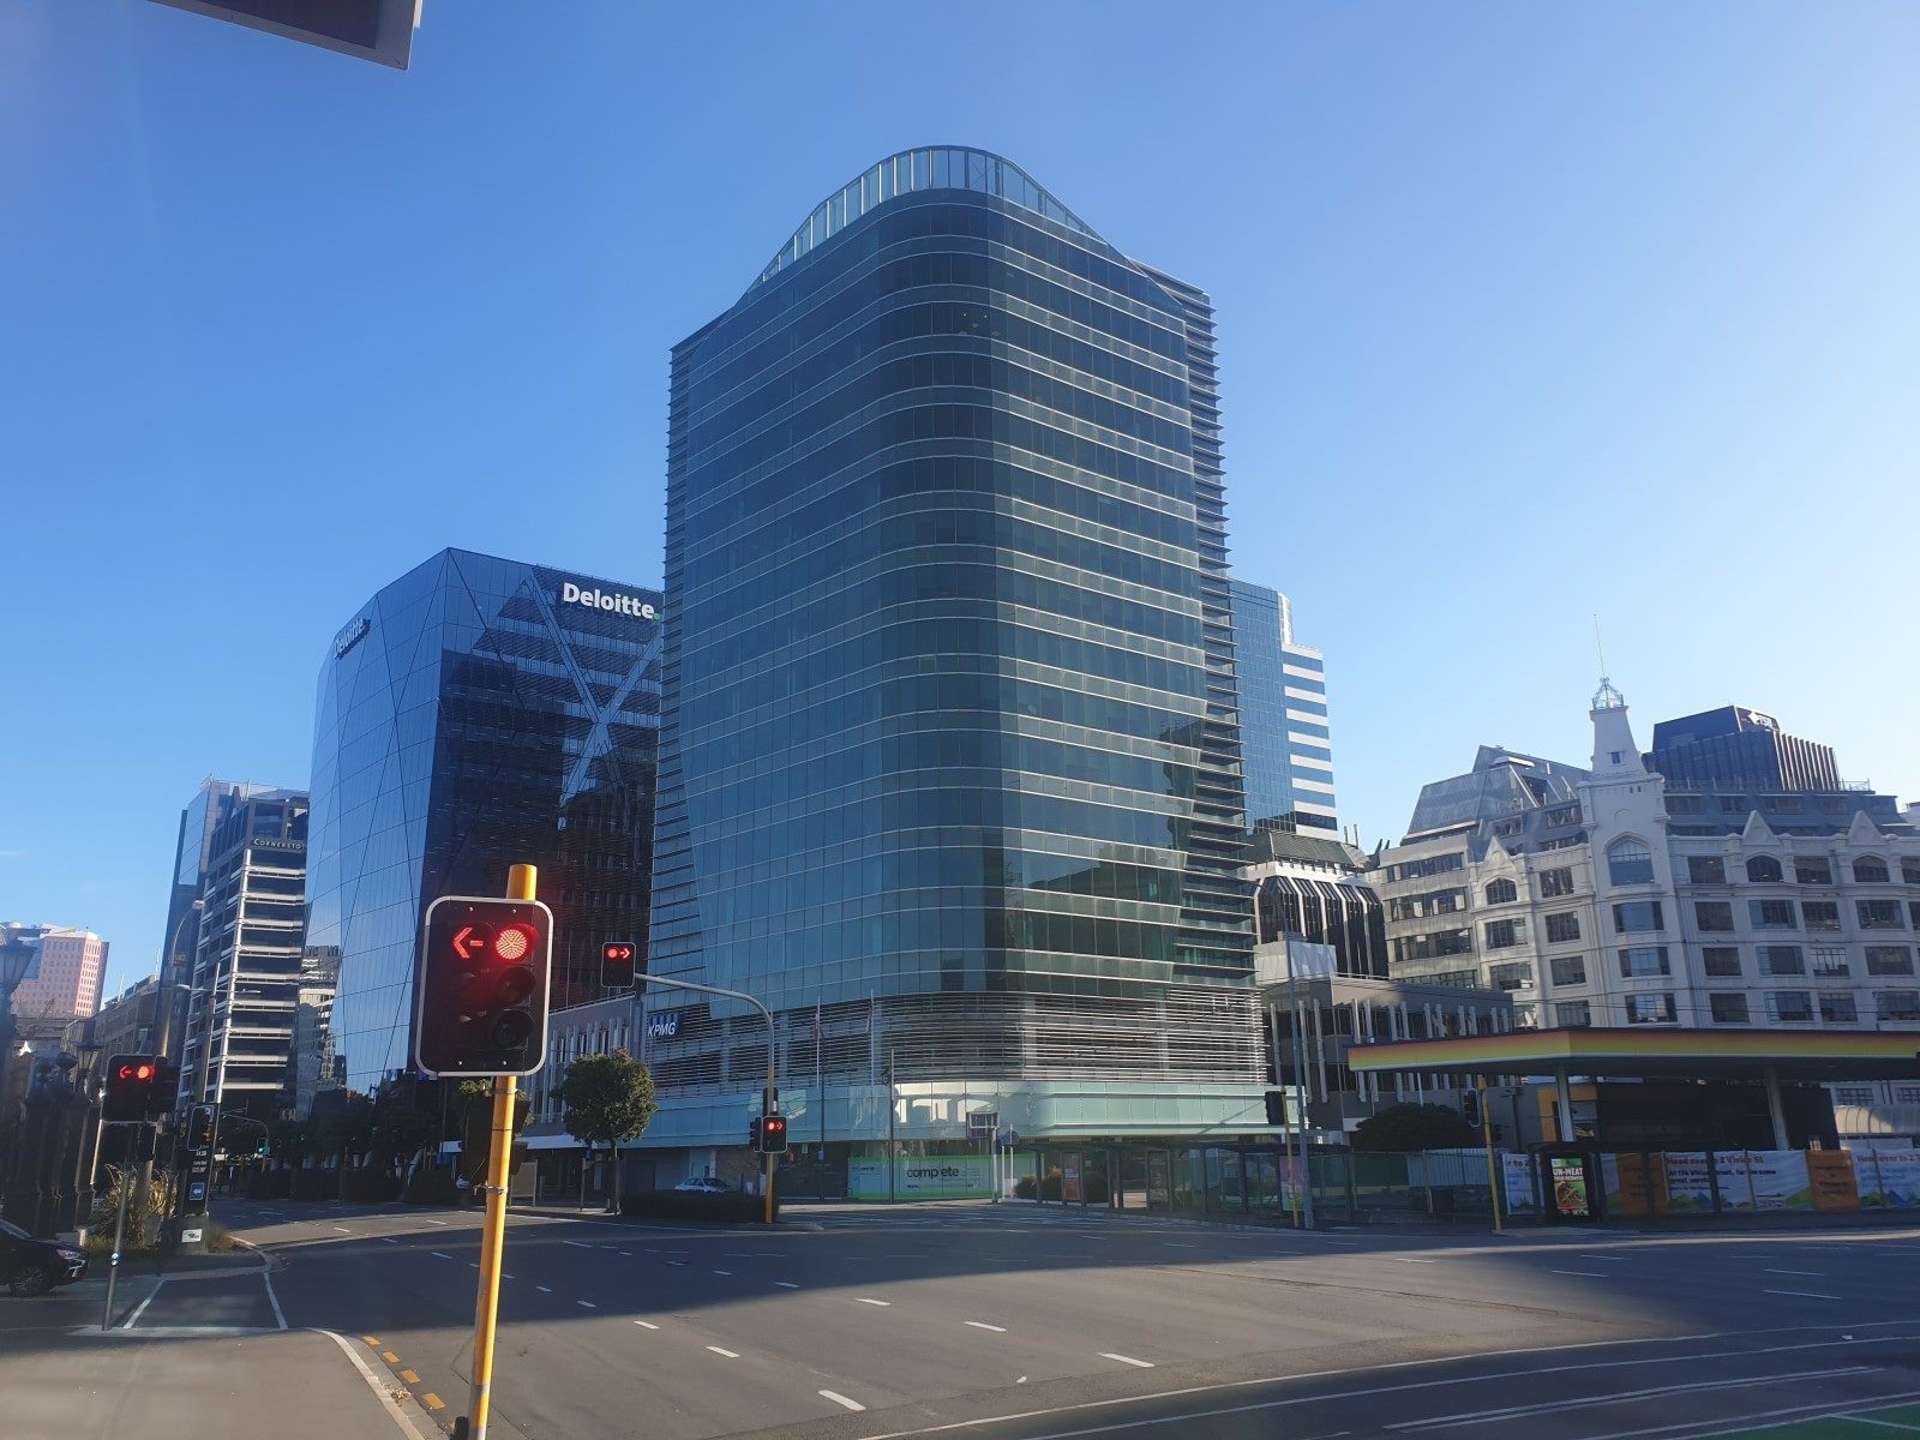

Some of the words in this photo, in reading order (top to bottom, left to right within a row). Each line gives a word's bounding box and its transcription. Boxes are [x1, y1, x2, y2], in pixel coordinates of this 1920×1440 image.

[253, 838, 303, 850] CORNERSTO
[647, 1021, 676, 1038] KPMG
[906, 1166, 960, 1179] compete
